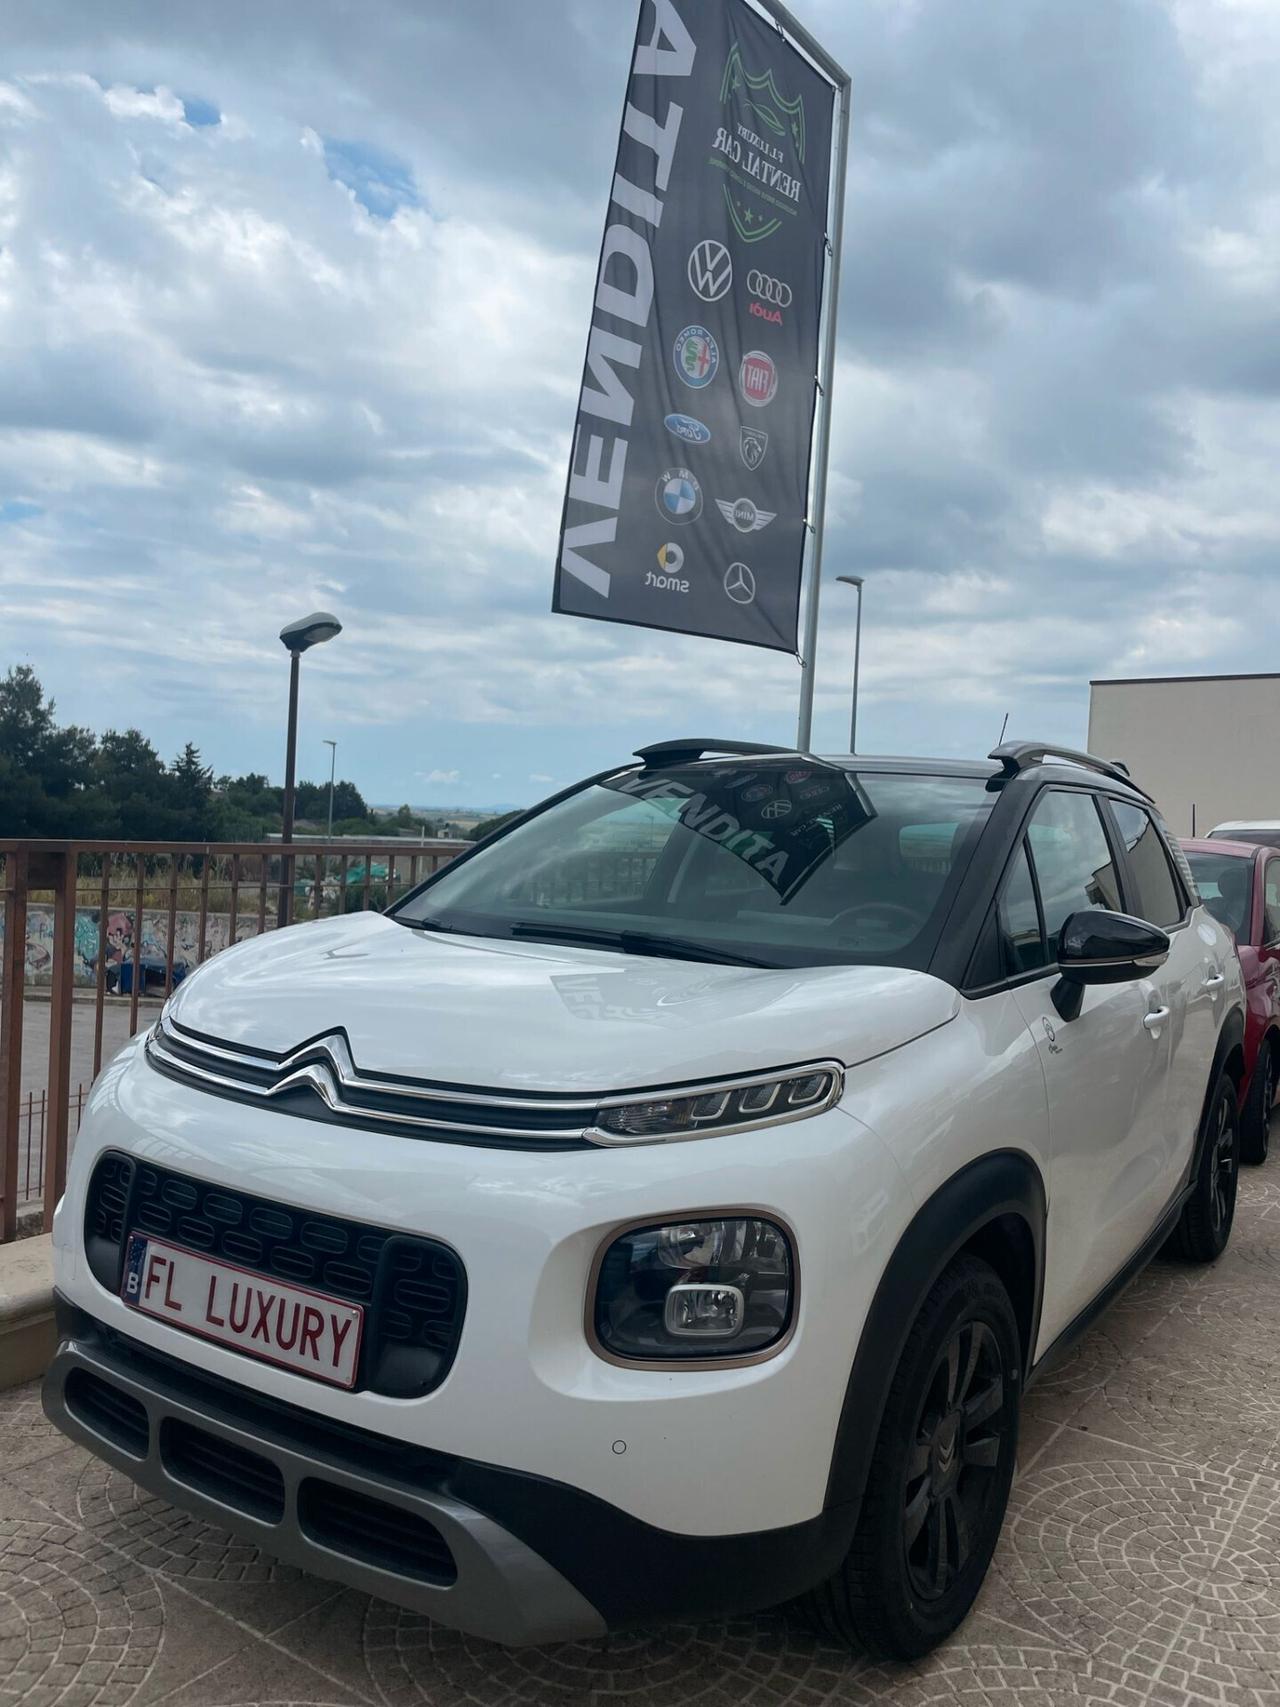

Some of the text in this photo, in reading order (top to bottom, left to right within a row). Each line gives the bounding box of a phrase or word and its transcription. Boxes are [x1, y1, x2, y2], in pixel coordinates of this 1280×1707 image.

[126, 1272, 140, 1295] B
[144, 1254, 353, 1368] FL LUXURY
